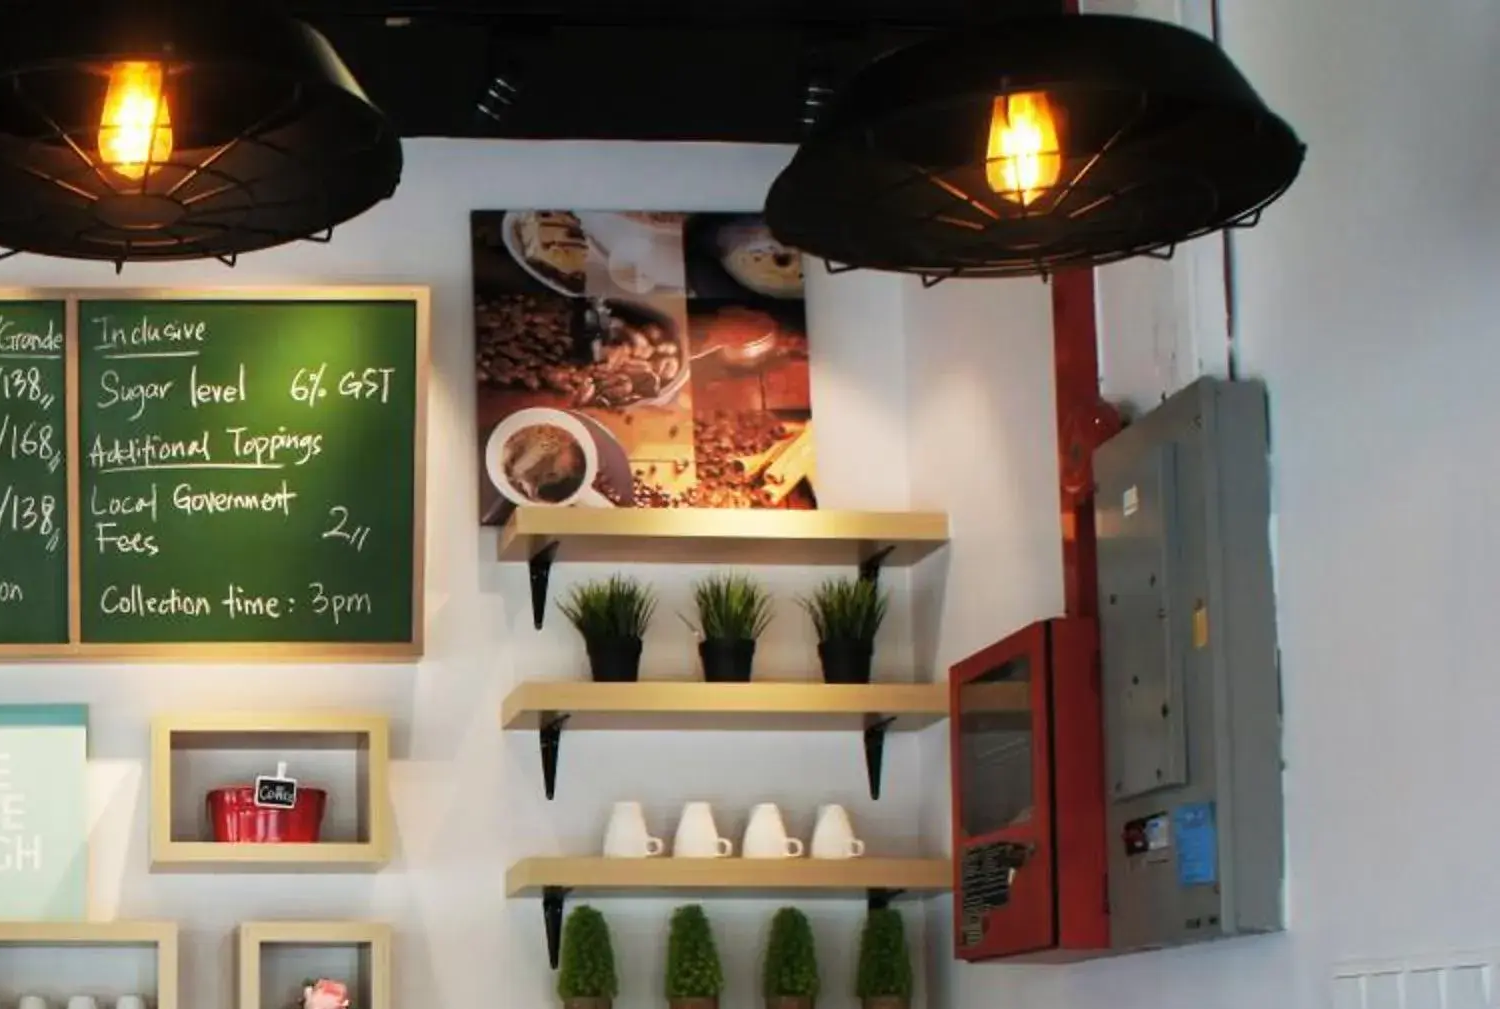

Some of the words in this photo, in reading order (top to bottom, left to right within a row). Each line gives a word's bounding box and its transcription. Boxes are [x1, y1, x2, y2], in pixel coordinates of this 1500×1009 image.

[93, 316, 207, 350] Inclusive
[97, 369, 174, 421] Sugar
[190, 363, 246, 408] level
[290, 363, 328, 407] 6%
[338, 367, 396, 403] GST
[89, 430, 211, 469] Additional
[226, 427, 323, 466] Toppings
[90, 484, 157, 522] Local
[95, 523, 160, 556] Fees
[100, 584, 211, 617] Collection
[309, 582, 372, 624] 3pm
